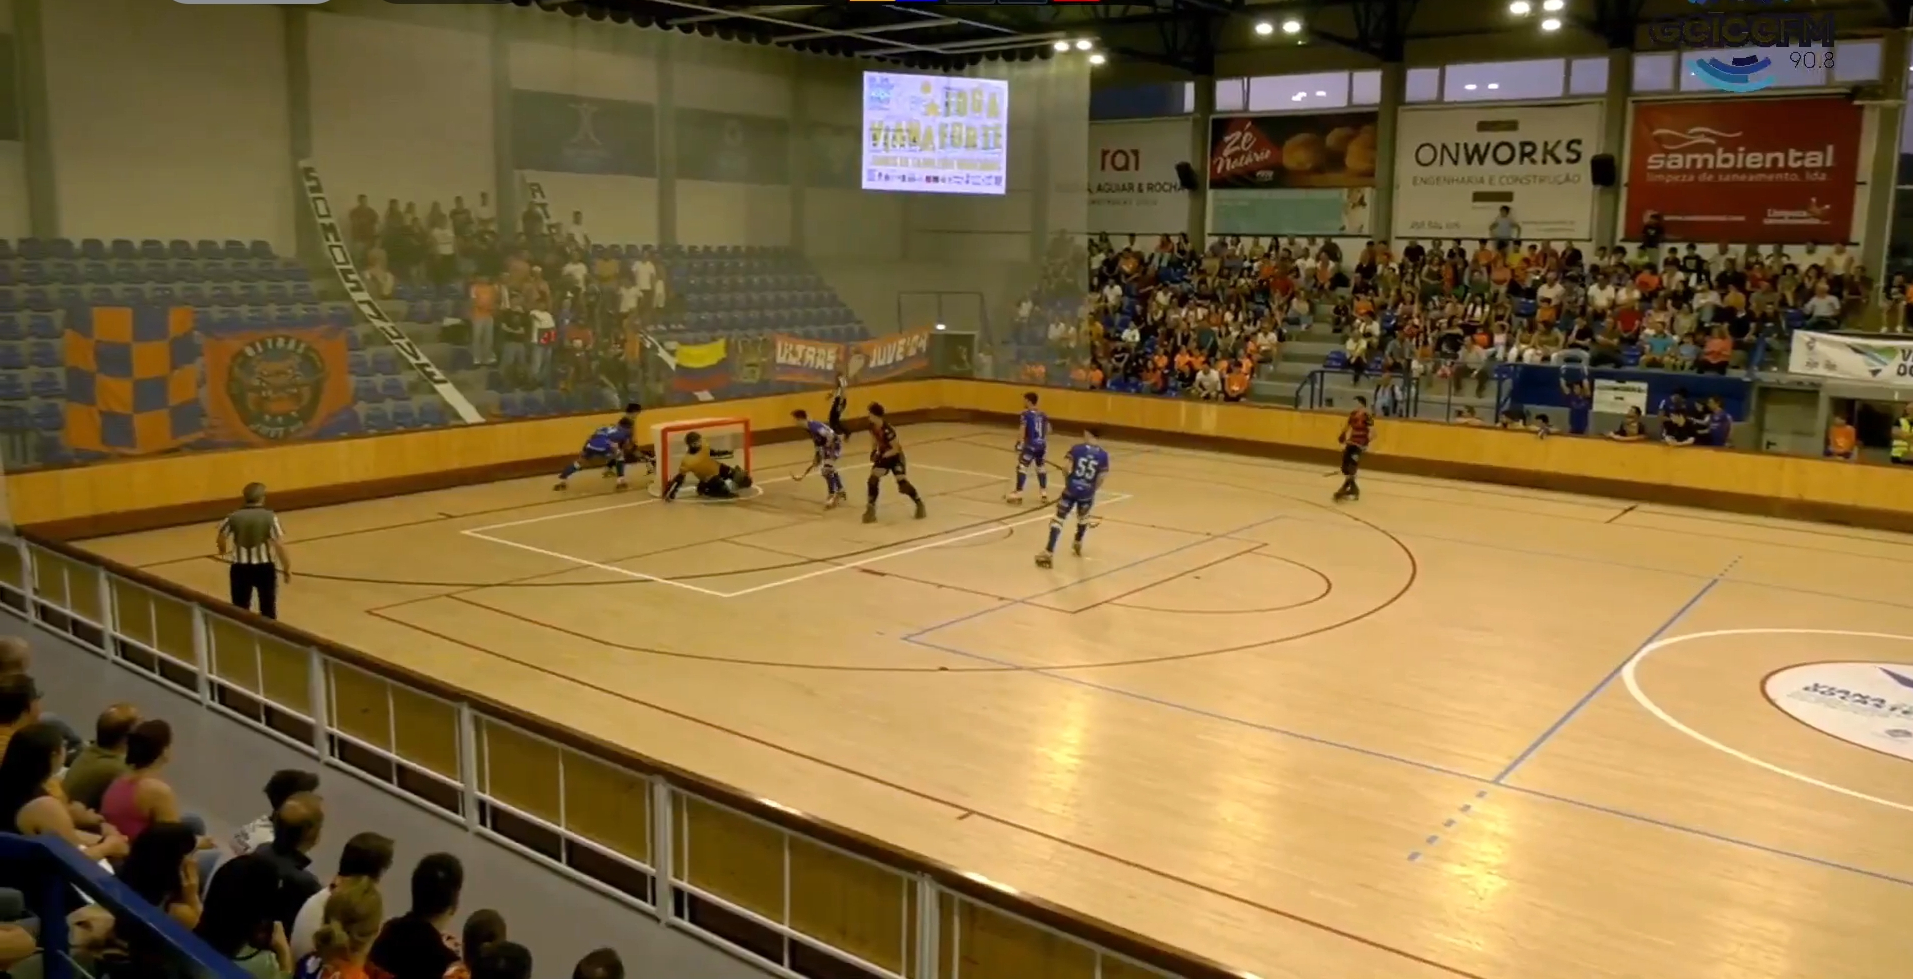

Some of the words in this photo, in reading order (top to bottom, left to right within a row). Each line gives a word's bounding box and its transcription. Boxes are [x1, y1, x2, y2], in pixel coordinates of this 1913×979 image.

[1222, 121, 1257, 157] Zé
[1414, 139, 1583, 167] ONWORKS
[1646, 144, 1835, 170] sambiental
[1412, 174, 1487, 187] ENGENHARIA
[1489, 174, 1497, 186] E
[1498, 171, 1581, 187] CONSTRUÇÃO
[1698, 171, 1714, 181] de
[775, 340, 838, 371] ULTRAS
[1034, 417, 1044, 438] 4
[1076, 457, 1099, 481] 55
